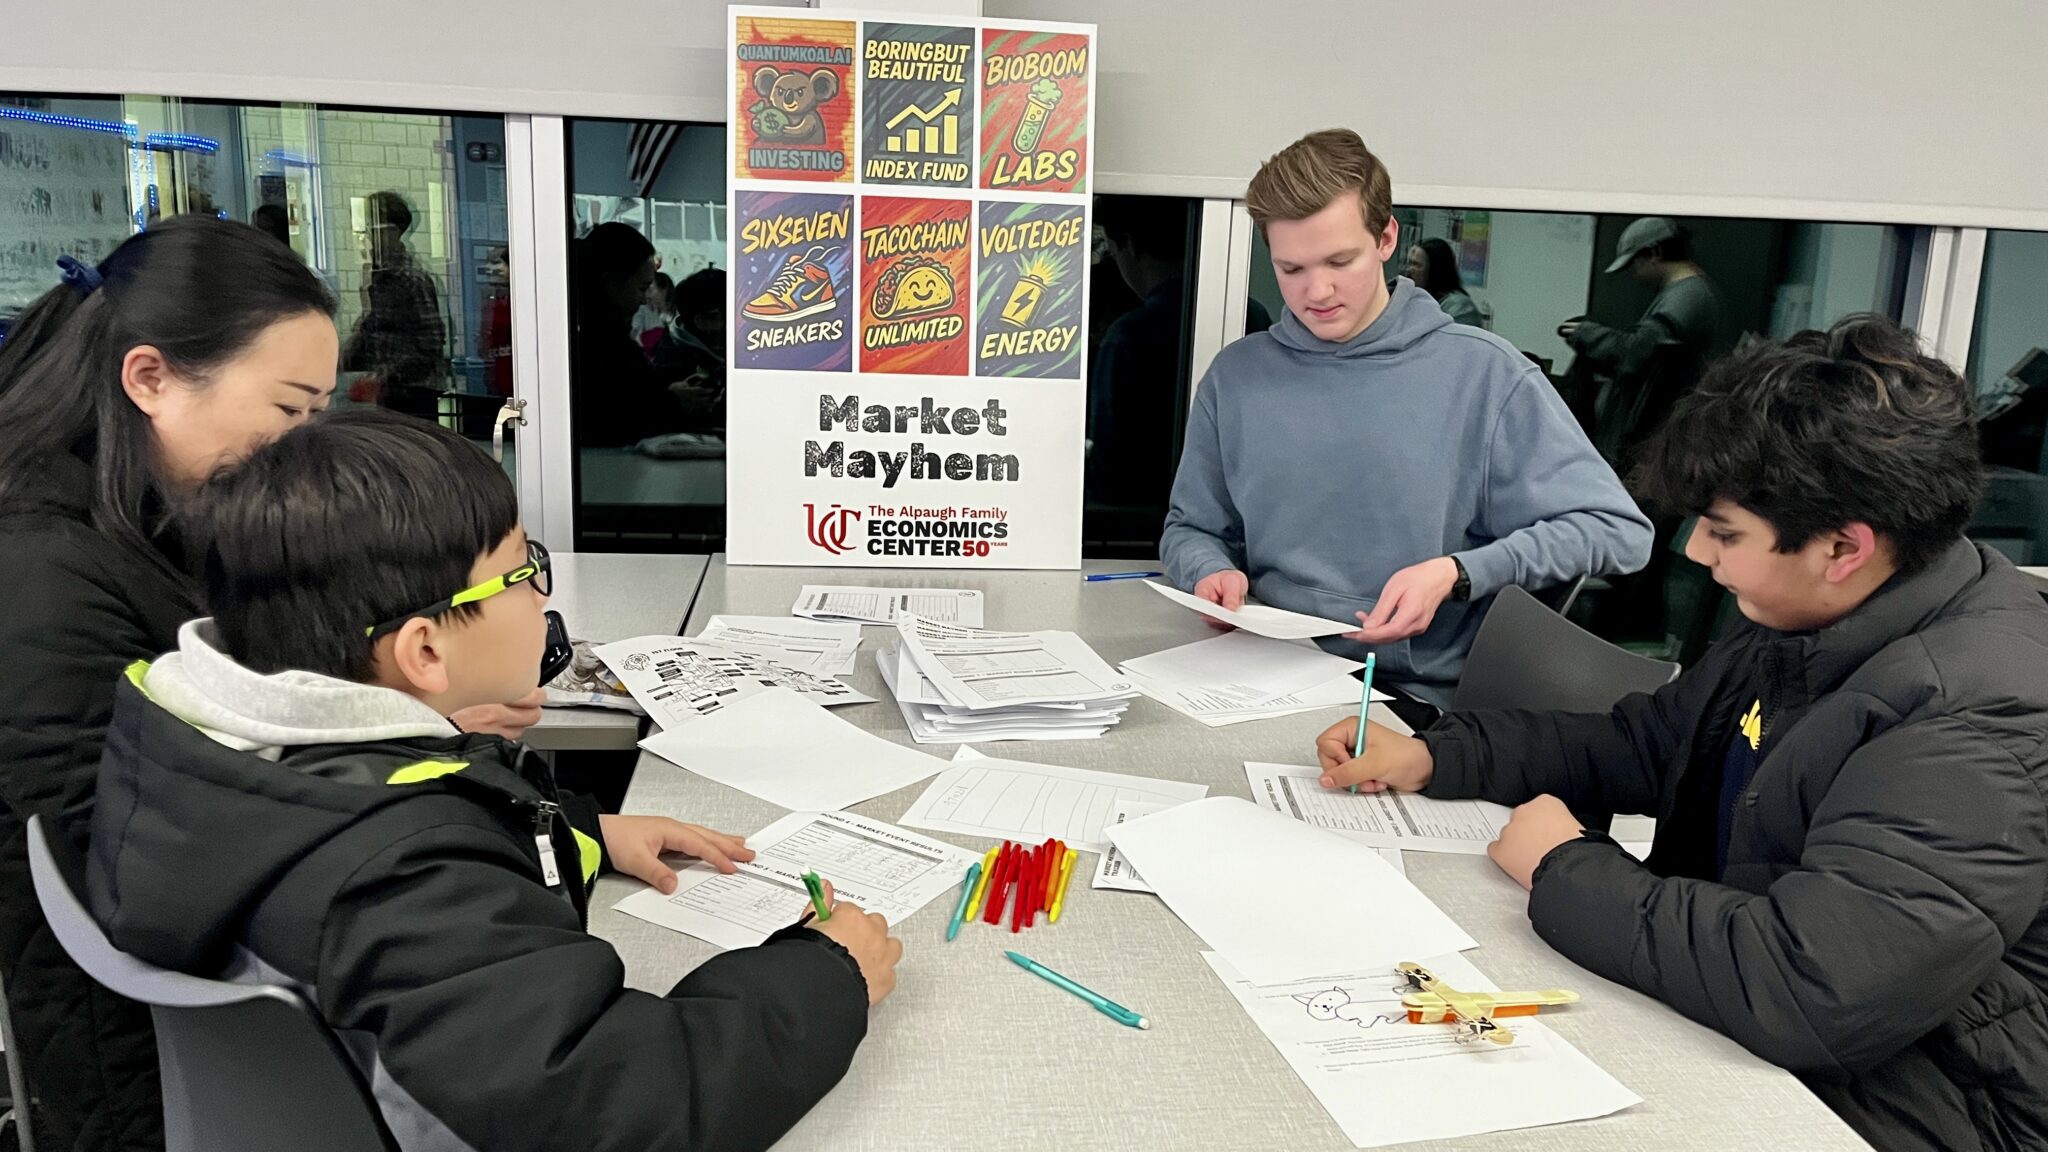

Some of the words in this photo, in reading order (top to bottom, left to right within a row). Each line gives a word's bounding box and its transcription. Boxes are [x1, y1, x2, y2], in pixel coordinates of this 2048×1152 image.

[738, 44, 852, 65] QUANTUMKOALAI
[865, 40, 970, 63] BORINGBUT
[868, 59, 965, 83] BEAUTIFUL
[986, 48, 1087, 87] BIOBOOM
[750, 149, 844, 171] INVESTING
[866, 160, 920, 179] INDEX
[922, 162, 968, 182] FUND
[991, 149, 1077, 185] LABS
[742, 208, 850, 254] SIXSEVEN
[864, 217, 969, 259] TACOCHAIN
[981, 216, 1083, 257] VOLTEDGE
[747, 320, 843, 350] SNEAKERS
[866, 316, 963, 347] UNLIMITED
[980, 325, 1077, 359] ENERGY
[820, 395, 1007, 436] Market
[804, 440, 1020, 488] Mayhem
[869, 505, 894, 517] The
[900, 506, 956, 520] Alpaugh
[962, 507, 1008, 521] Family
[868, 520, 1008, 538] ECONOMICS
[856, 823, 886, 836] MARKET
[886, 833, 910, 844] EVENT
[910, 840, 944, 854] RESULTS
[775, 870, 803, 880] MARKE
